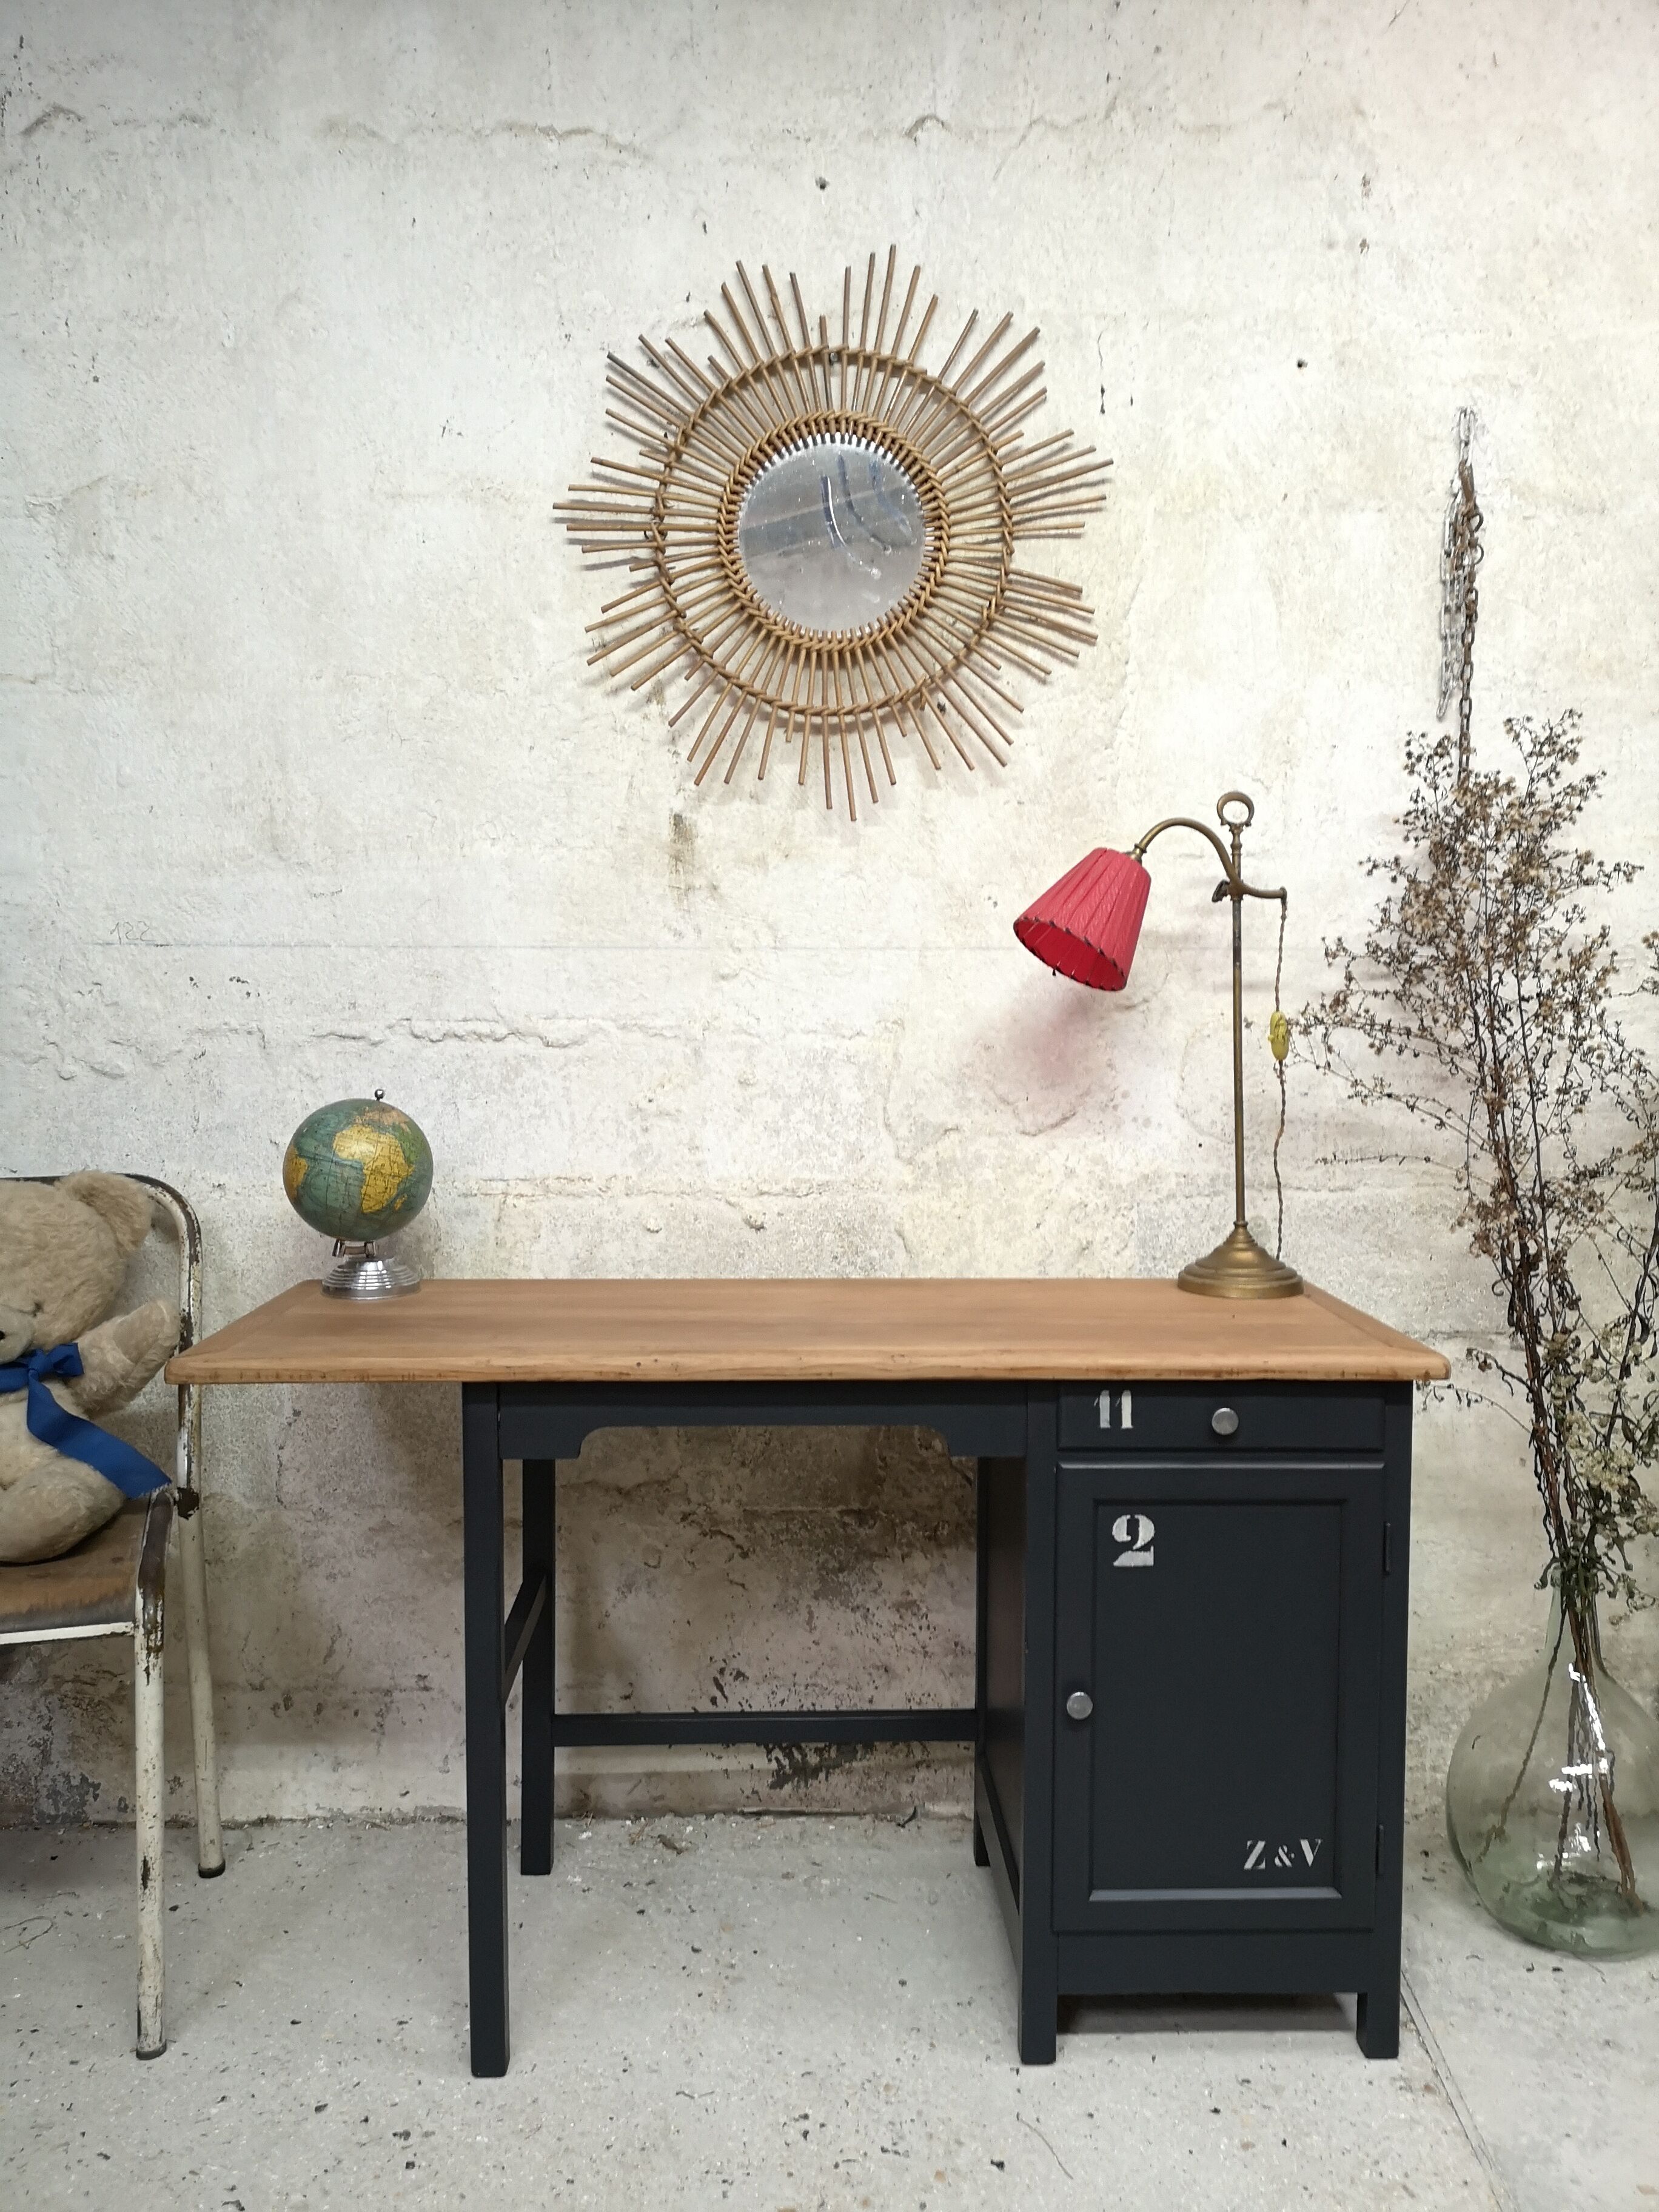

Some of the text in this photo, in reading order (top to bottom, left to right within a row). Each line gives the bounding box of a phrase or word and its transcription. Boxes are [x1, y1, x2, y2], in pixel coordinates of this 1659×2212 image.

[110, 920, 156, 945] 122
[1094, 1389, 1133, 1429] 11
[1112, 1514, 1155, 1567] 2
